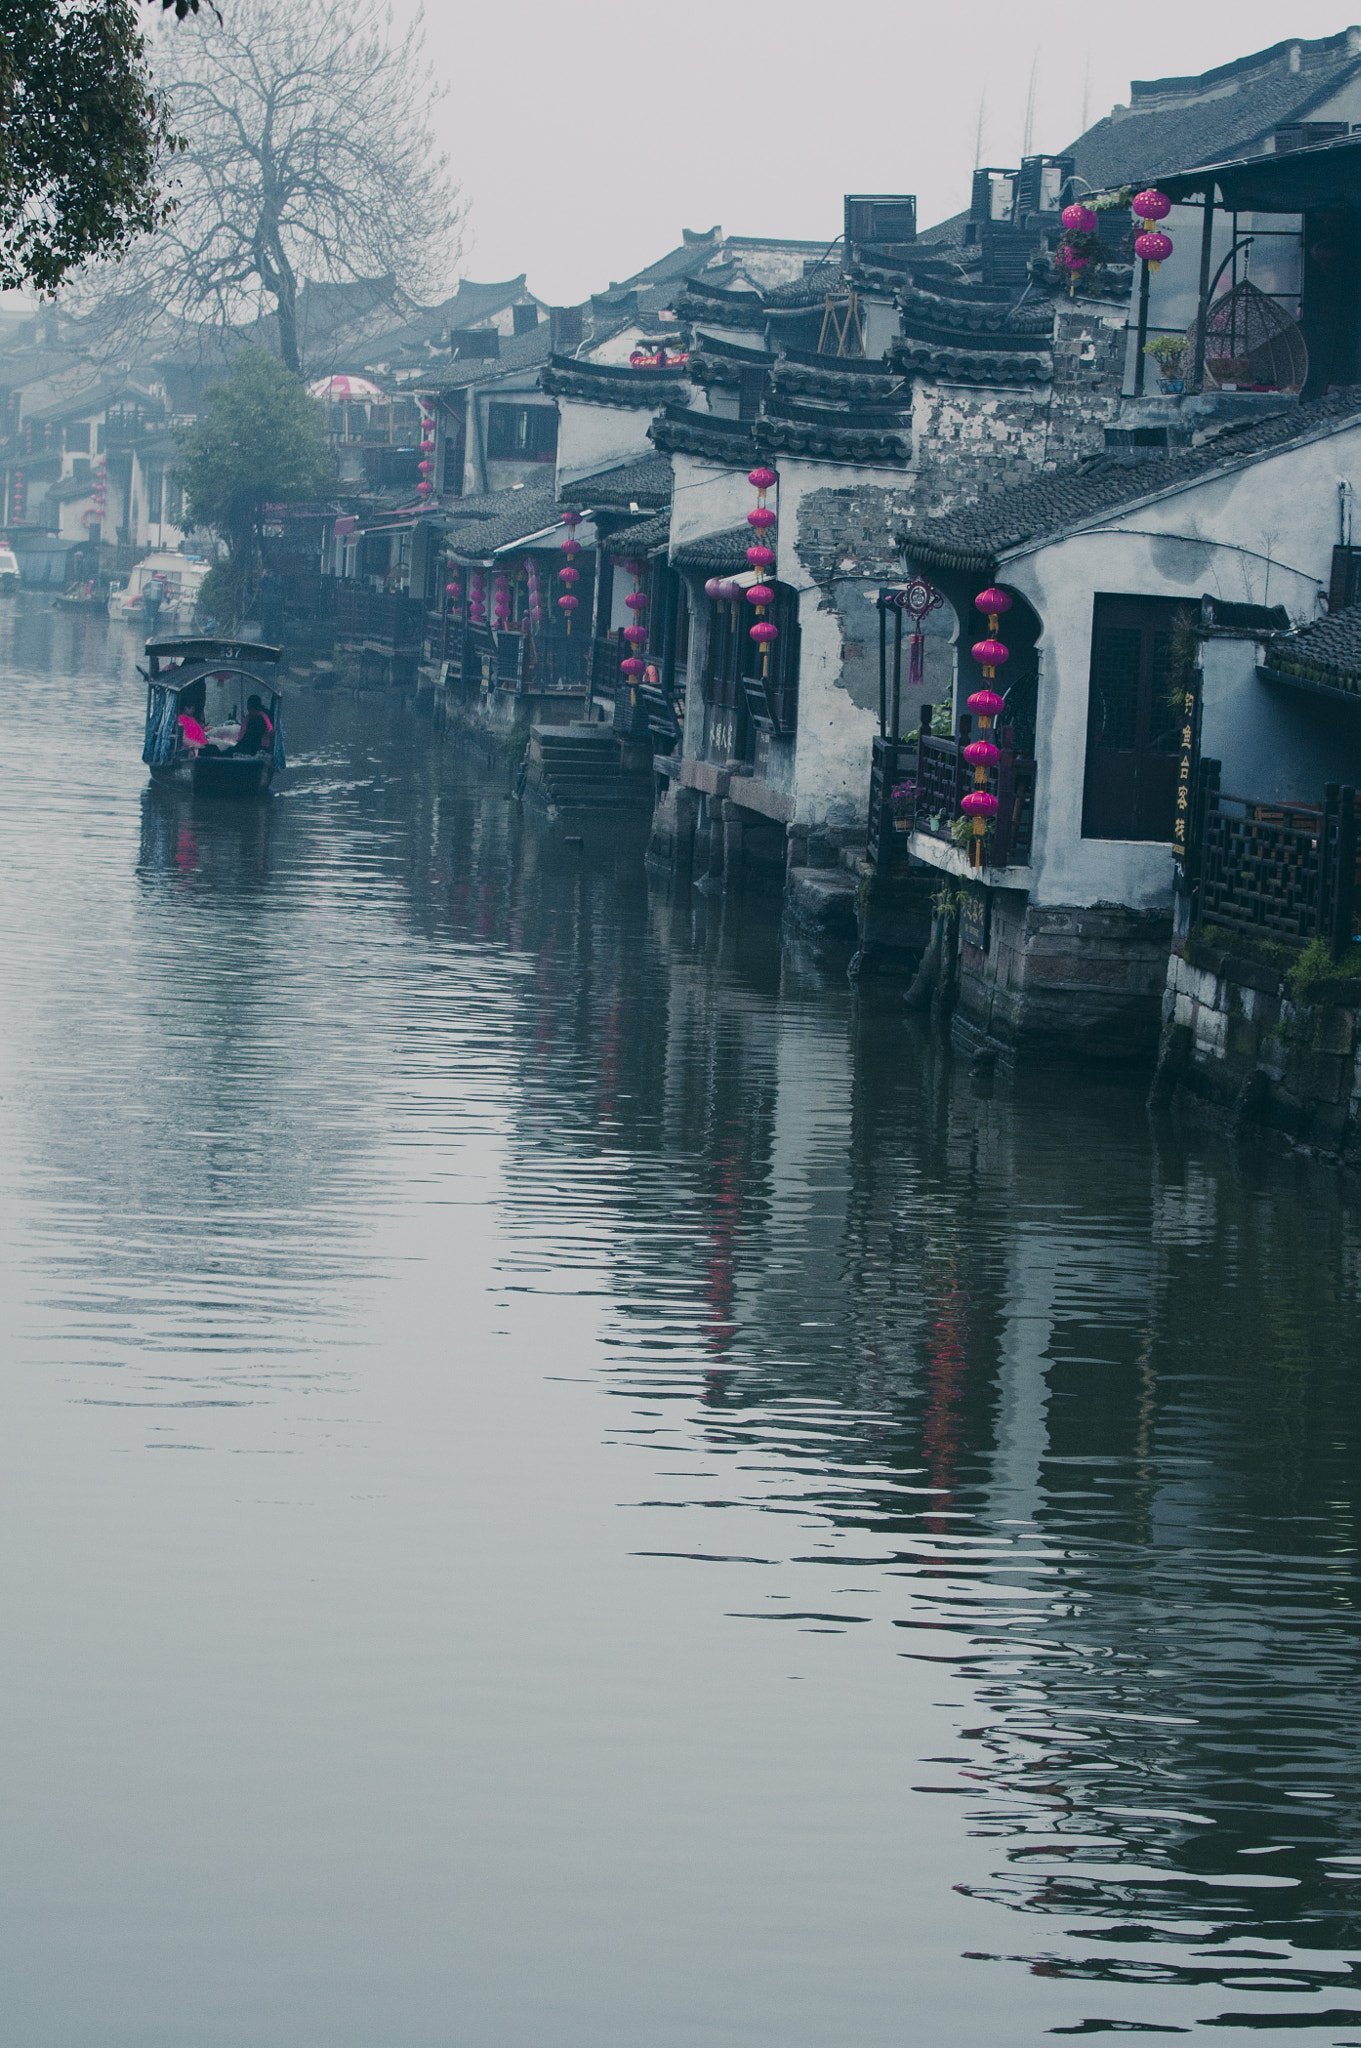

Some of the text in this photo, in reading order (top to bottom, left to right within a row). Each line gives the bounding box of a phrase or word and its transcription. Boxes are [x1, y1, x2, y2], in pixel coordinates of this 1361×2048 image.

[225, 646, 242, 658] 37
[1174, 691, 1194, 842] 钓鱼台客栈
